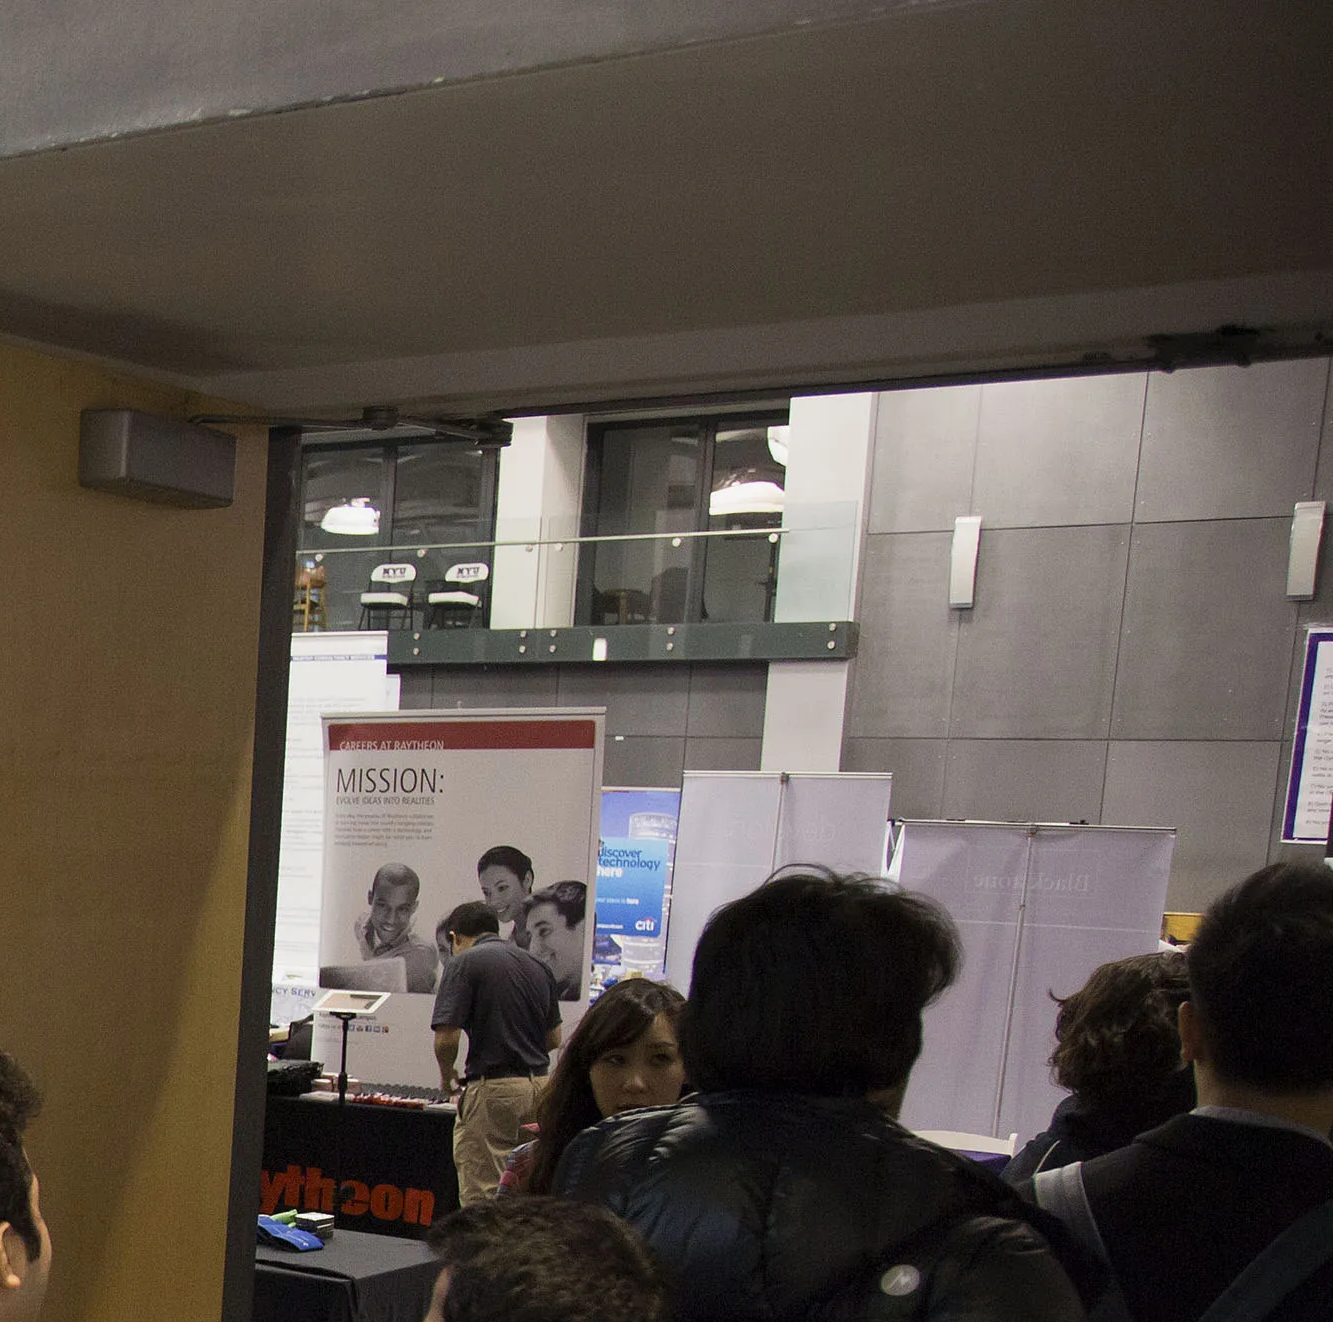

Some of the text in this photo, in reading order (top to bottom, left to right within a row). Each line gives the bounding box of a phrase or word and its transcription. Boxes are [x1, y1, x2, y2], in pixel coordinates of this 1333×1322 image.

[339, 739, 444, 751] CAREERS AT RAYTHEON
[336, 768, 444, 793] MISSION:
[598, 856, 661, 871] technology
[635, 918, 655, 931] citi
